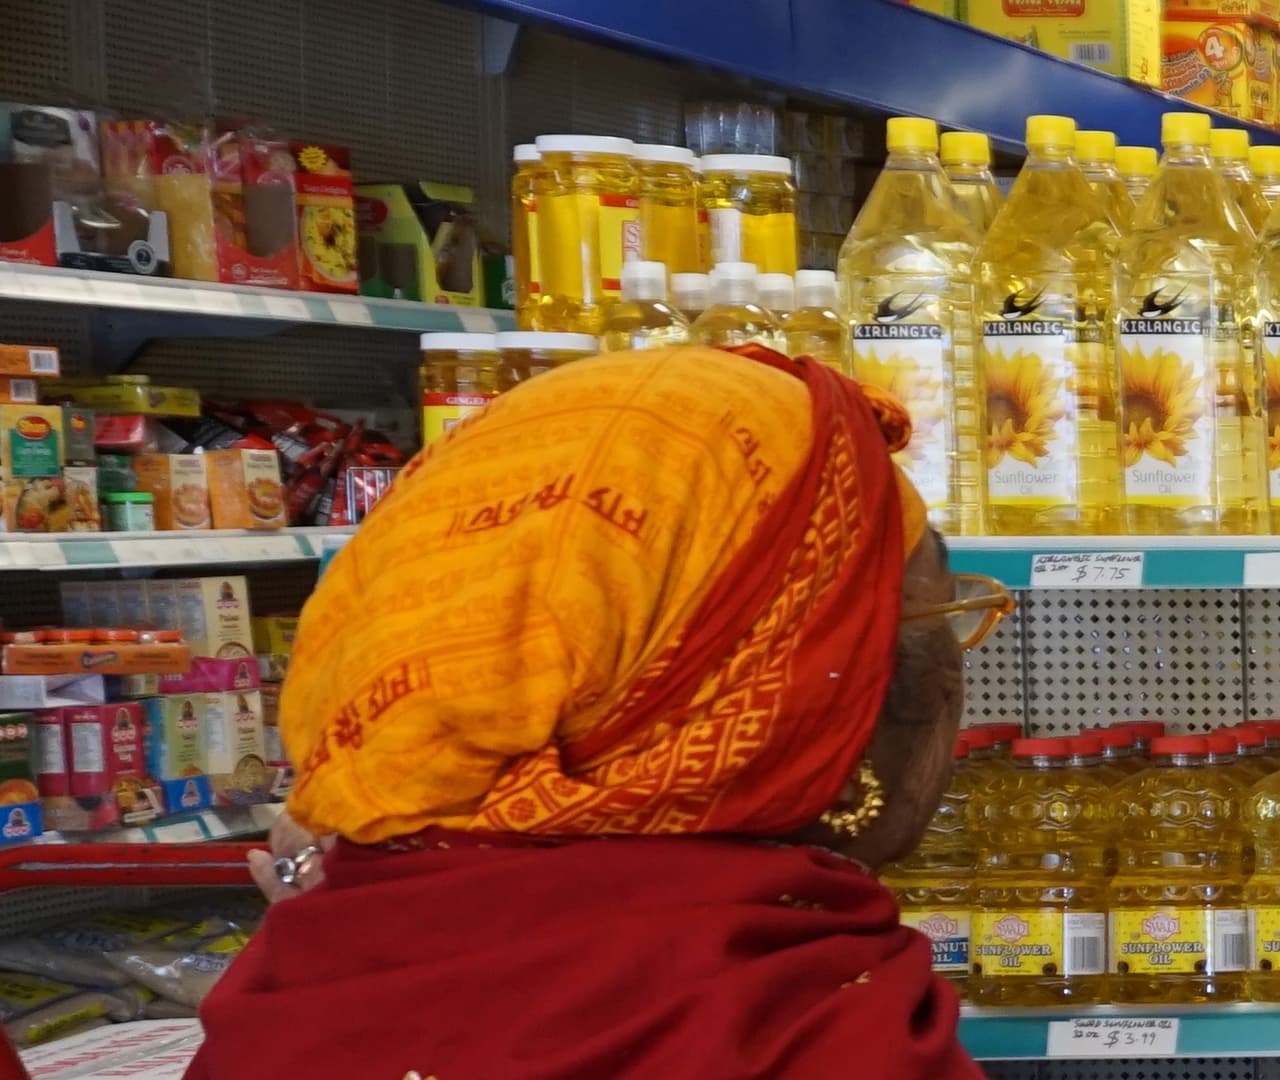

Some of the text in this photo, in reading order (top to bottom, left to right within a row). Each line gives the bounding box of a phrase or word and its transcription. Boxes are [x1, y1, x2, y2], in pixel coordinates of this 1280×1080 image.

[995, 470, 1059, 484] Sunflower
[1132, 470, 1197, 484] Sunflower
[930, 940, 968, 952] ANUT
[976, 944, 1052, 956] SUNFLOWER
[1122, 942, 1203, 953] SUNFLOWER
[1000, 957, 1021, 967] OIL
[1150, 954, 1172, 965] OIL
